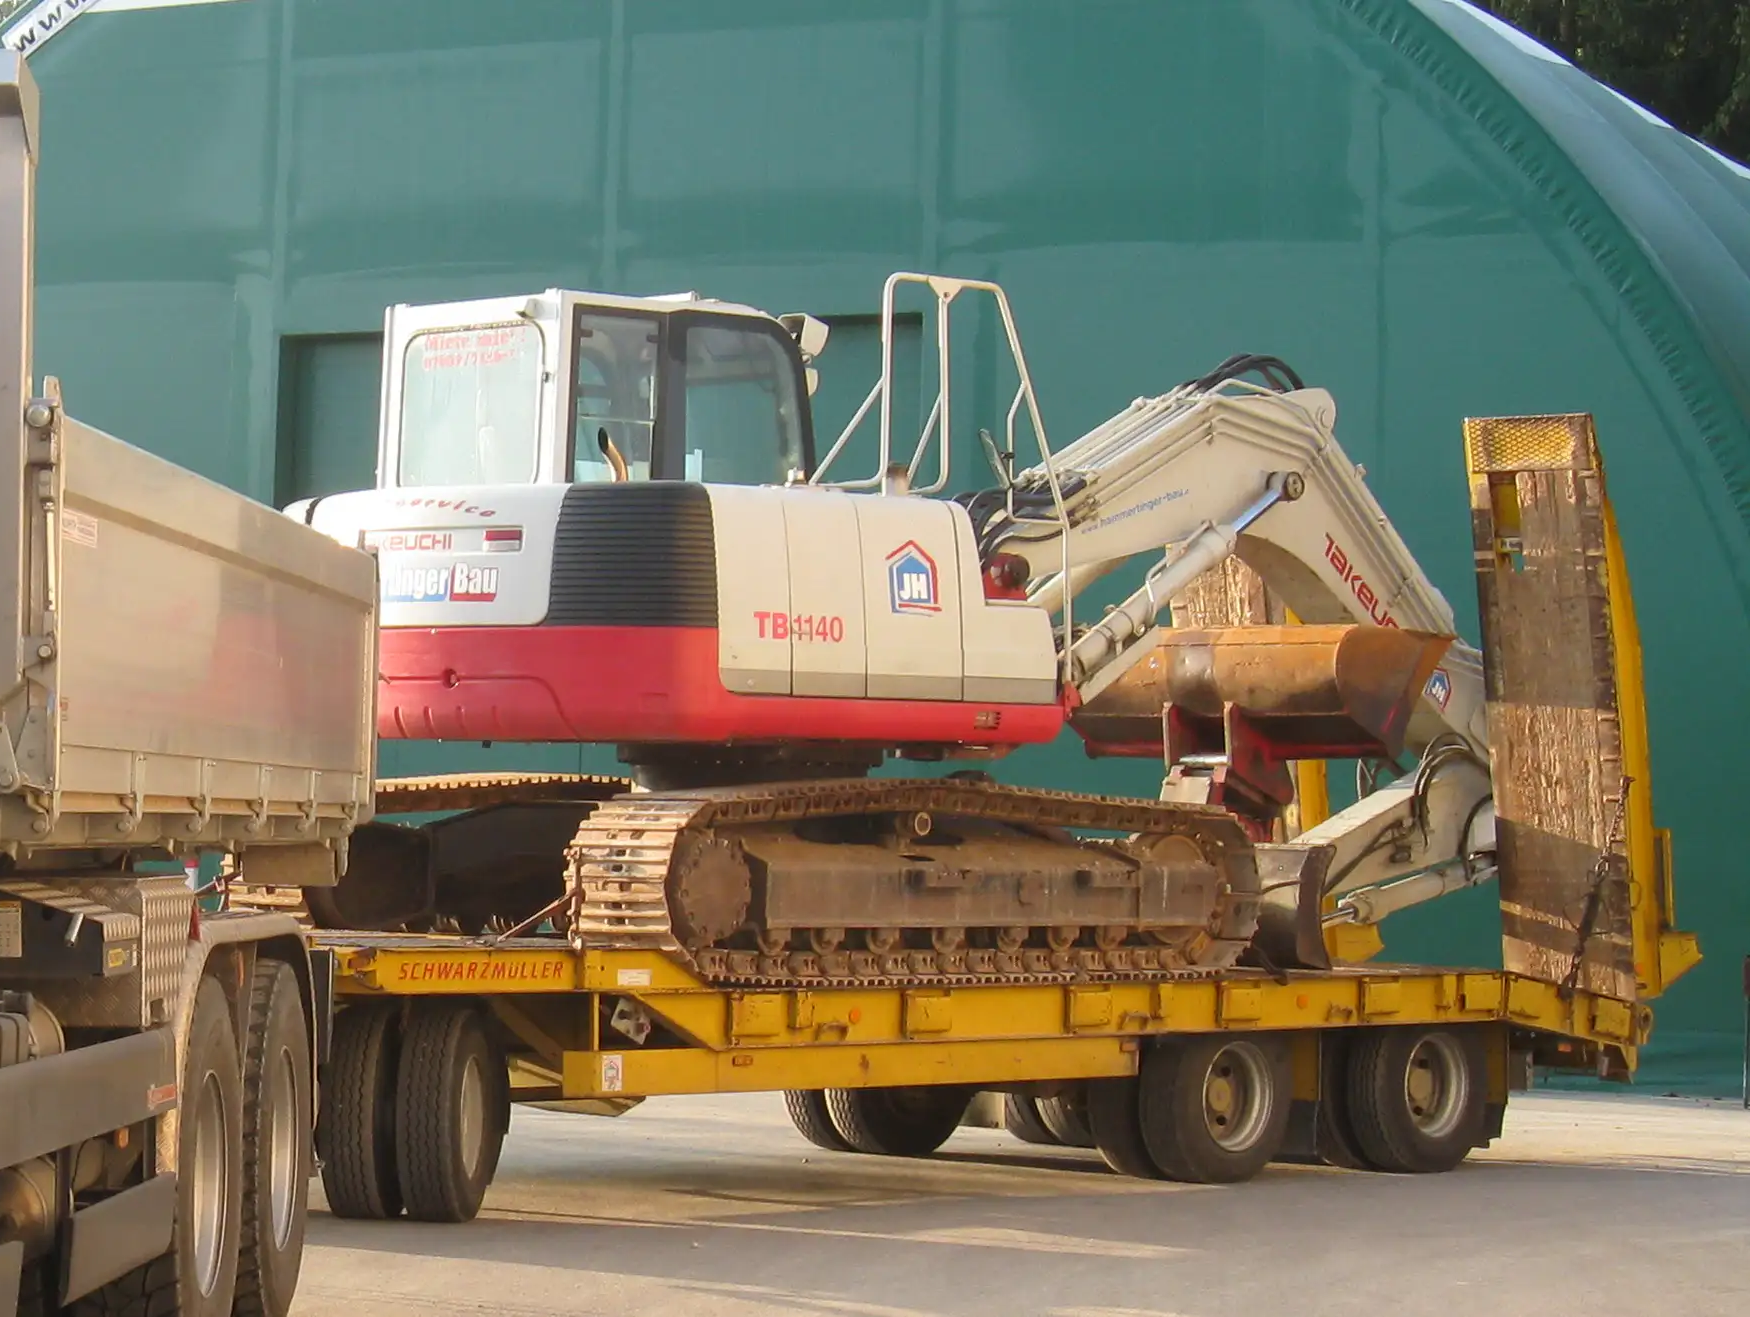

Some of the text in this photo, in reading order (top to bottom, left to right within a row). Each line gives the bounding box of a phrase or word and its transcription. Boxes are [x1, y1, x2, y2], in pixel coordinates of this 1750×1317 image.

[454, 562, 499, 595] Bau
[900, 573, 928, 600] JH
[753, 611, 844, 643] TB1140
[399, 961, 563, 981] SCHWARZMÜLLER
